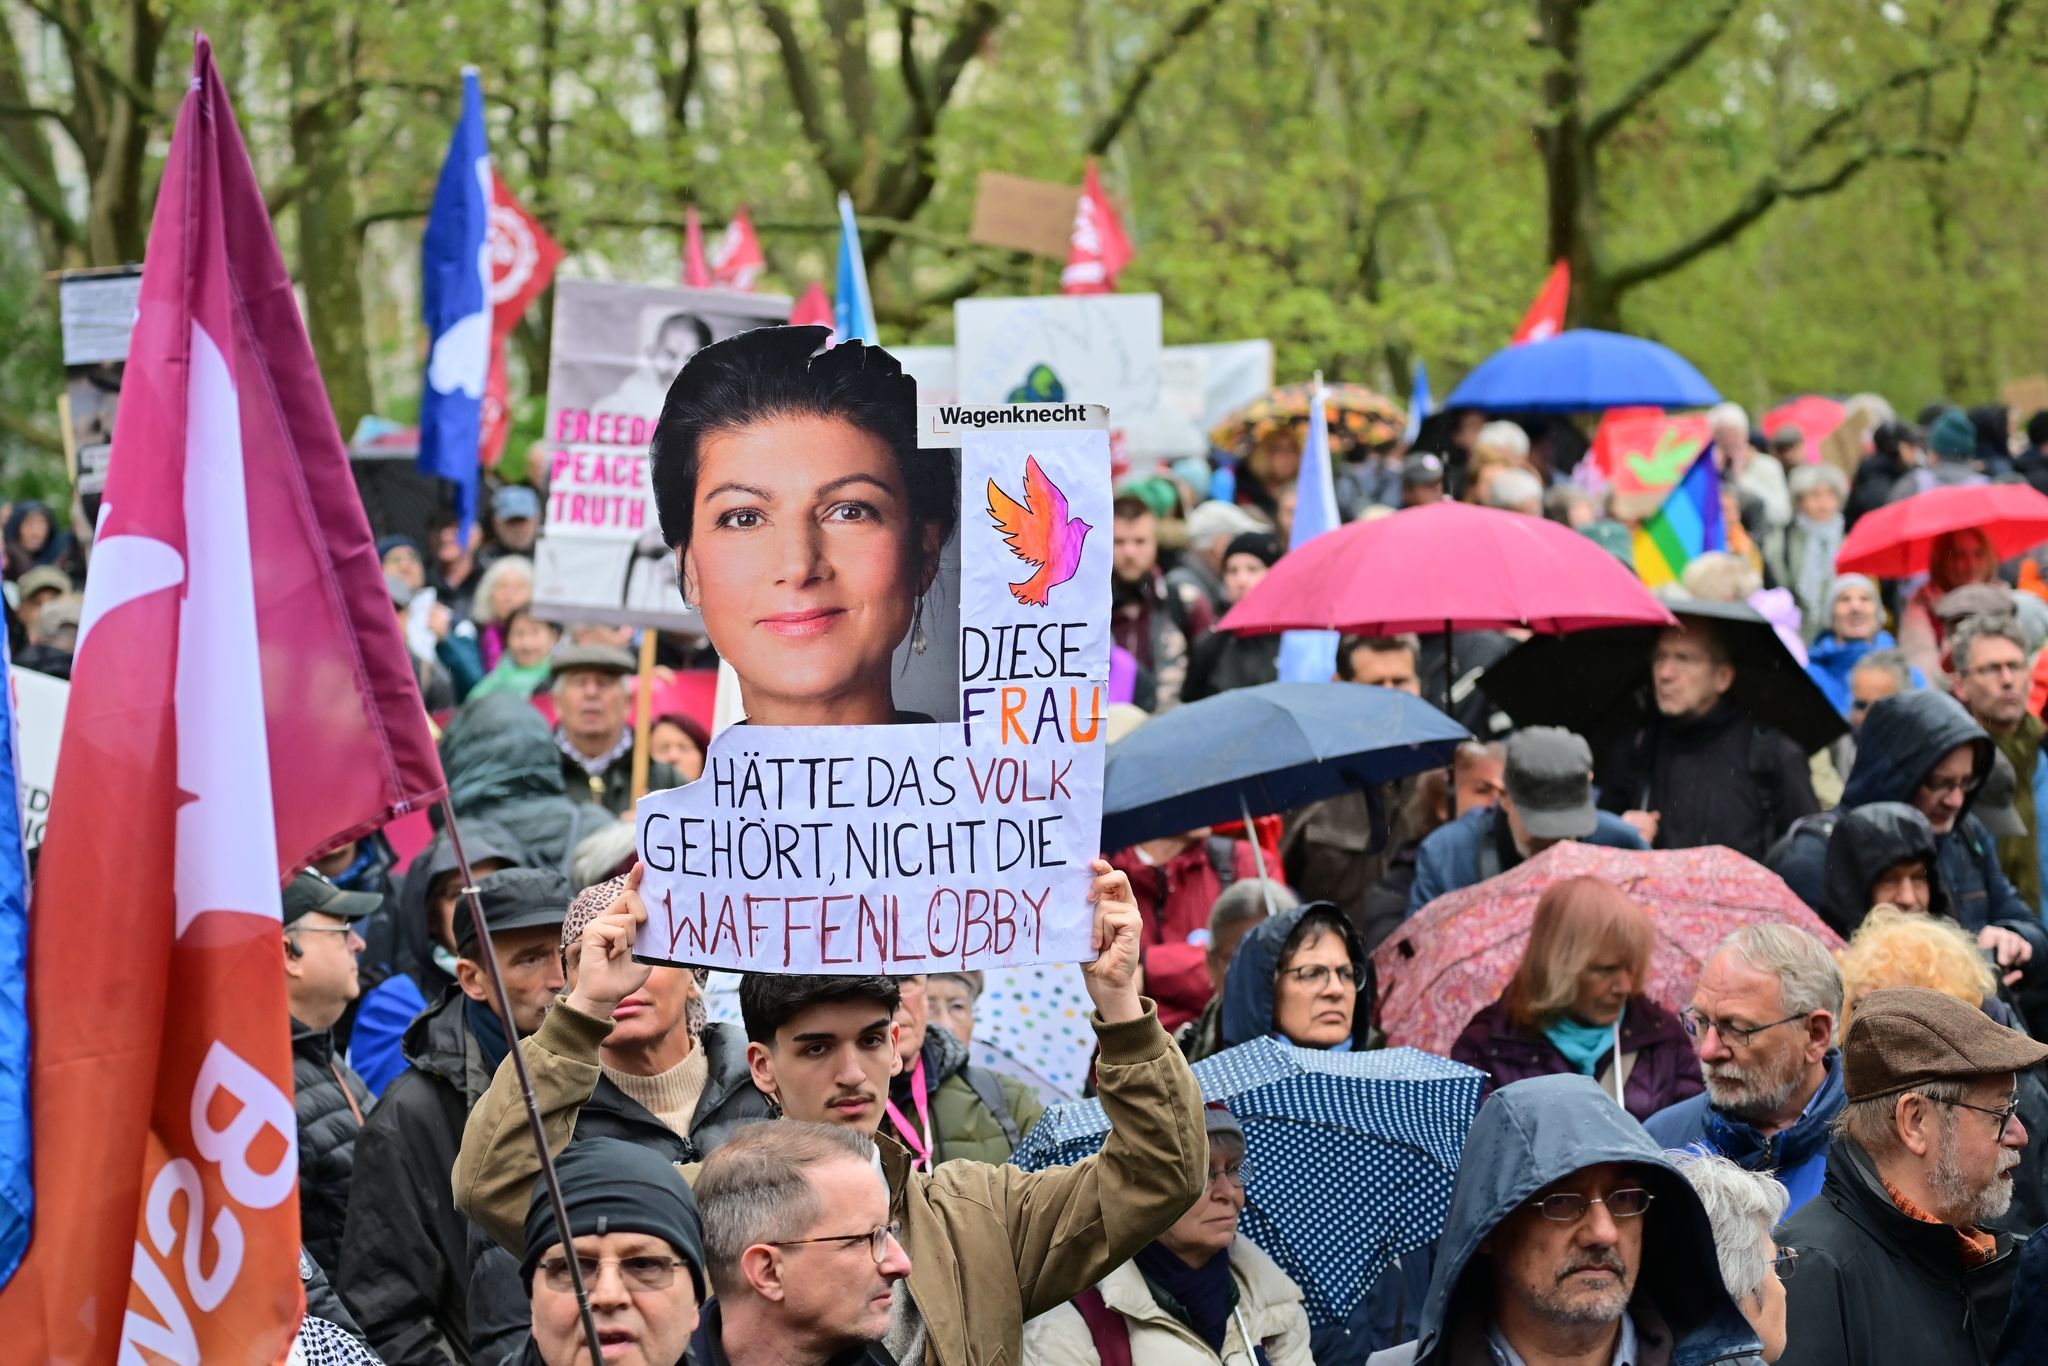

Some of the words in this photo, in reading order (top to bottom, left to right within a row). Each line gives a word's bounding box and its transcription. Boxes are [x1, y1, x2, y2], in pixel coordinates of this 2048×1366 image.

[555, 410, 659, 447] FREED
[940, 405, 1086, 428] Wagenknecht
[551, 450, 642, 488] PEACE
[552, 491, 645, 529] TRUTH
[962, 623, 1088, 682] DIESE
[963, 687, 1100, 747] FRAU
[713, 752, 855, 810] HÄTTE
[868, 756, 956, 807] DAS
[967, 757, 1073, 805] VOLK
[643, 814, 836, 886] GEHÖRT,
[846, 820, 986, 879] NICHT
[997, 815, 1067, 872] DIE
[664, 886, 1051, 972] WAFFENLOBBY
